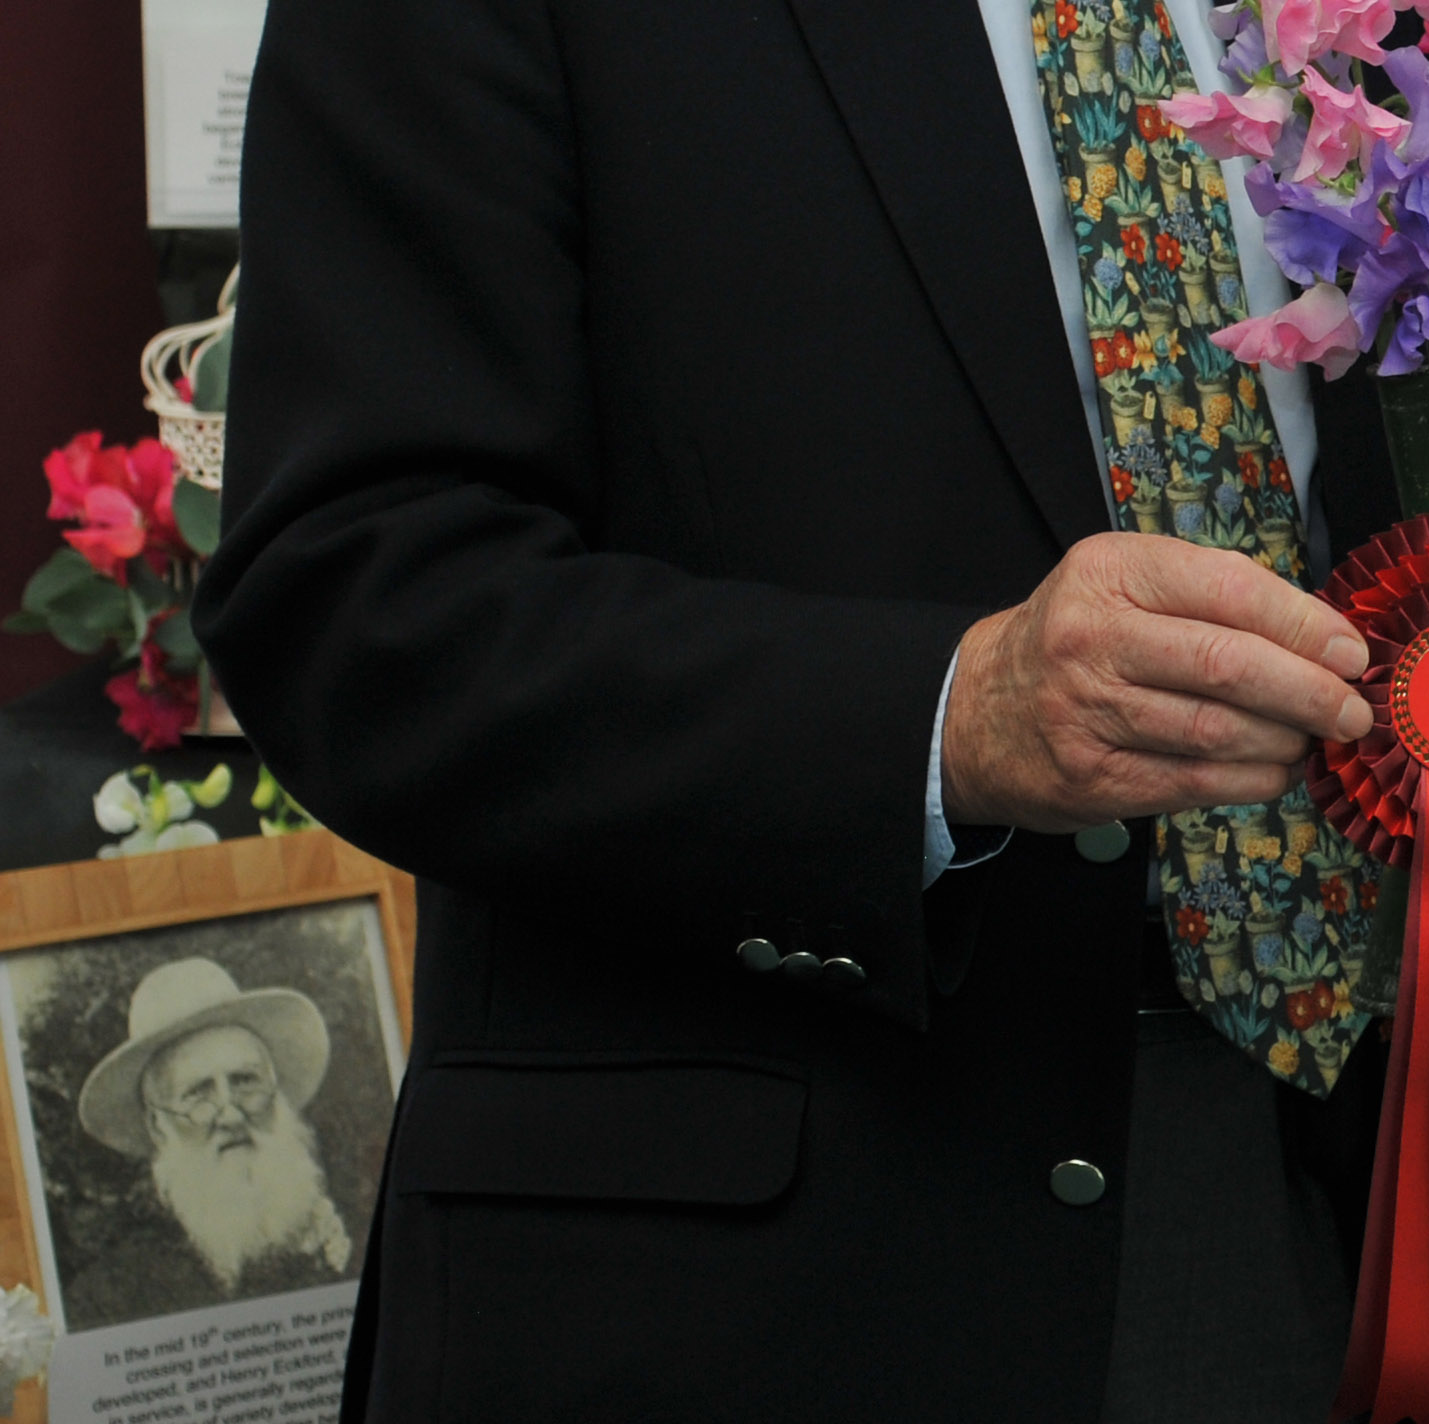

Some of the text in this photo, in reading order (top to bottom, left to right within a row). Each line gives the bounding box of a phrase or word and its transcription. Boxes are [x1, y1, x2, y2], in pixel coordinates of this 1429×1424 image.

[124, 1345, 150, 1363] the
[291, 1311, 316, 1329] the
[197, 1349, 229, 1369] and
[185, 1372, 217, 1393] and
